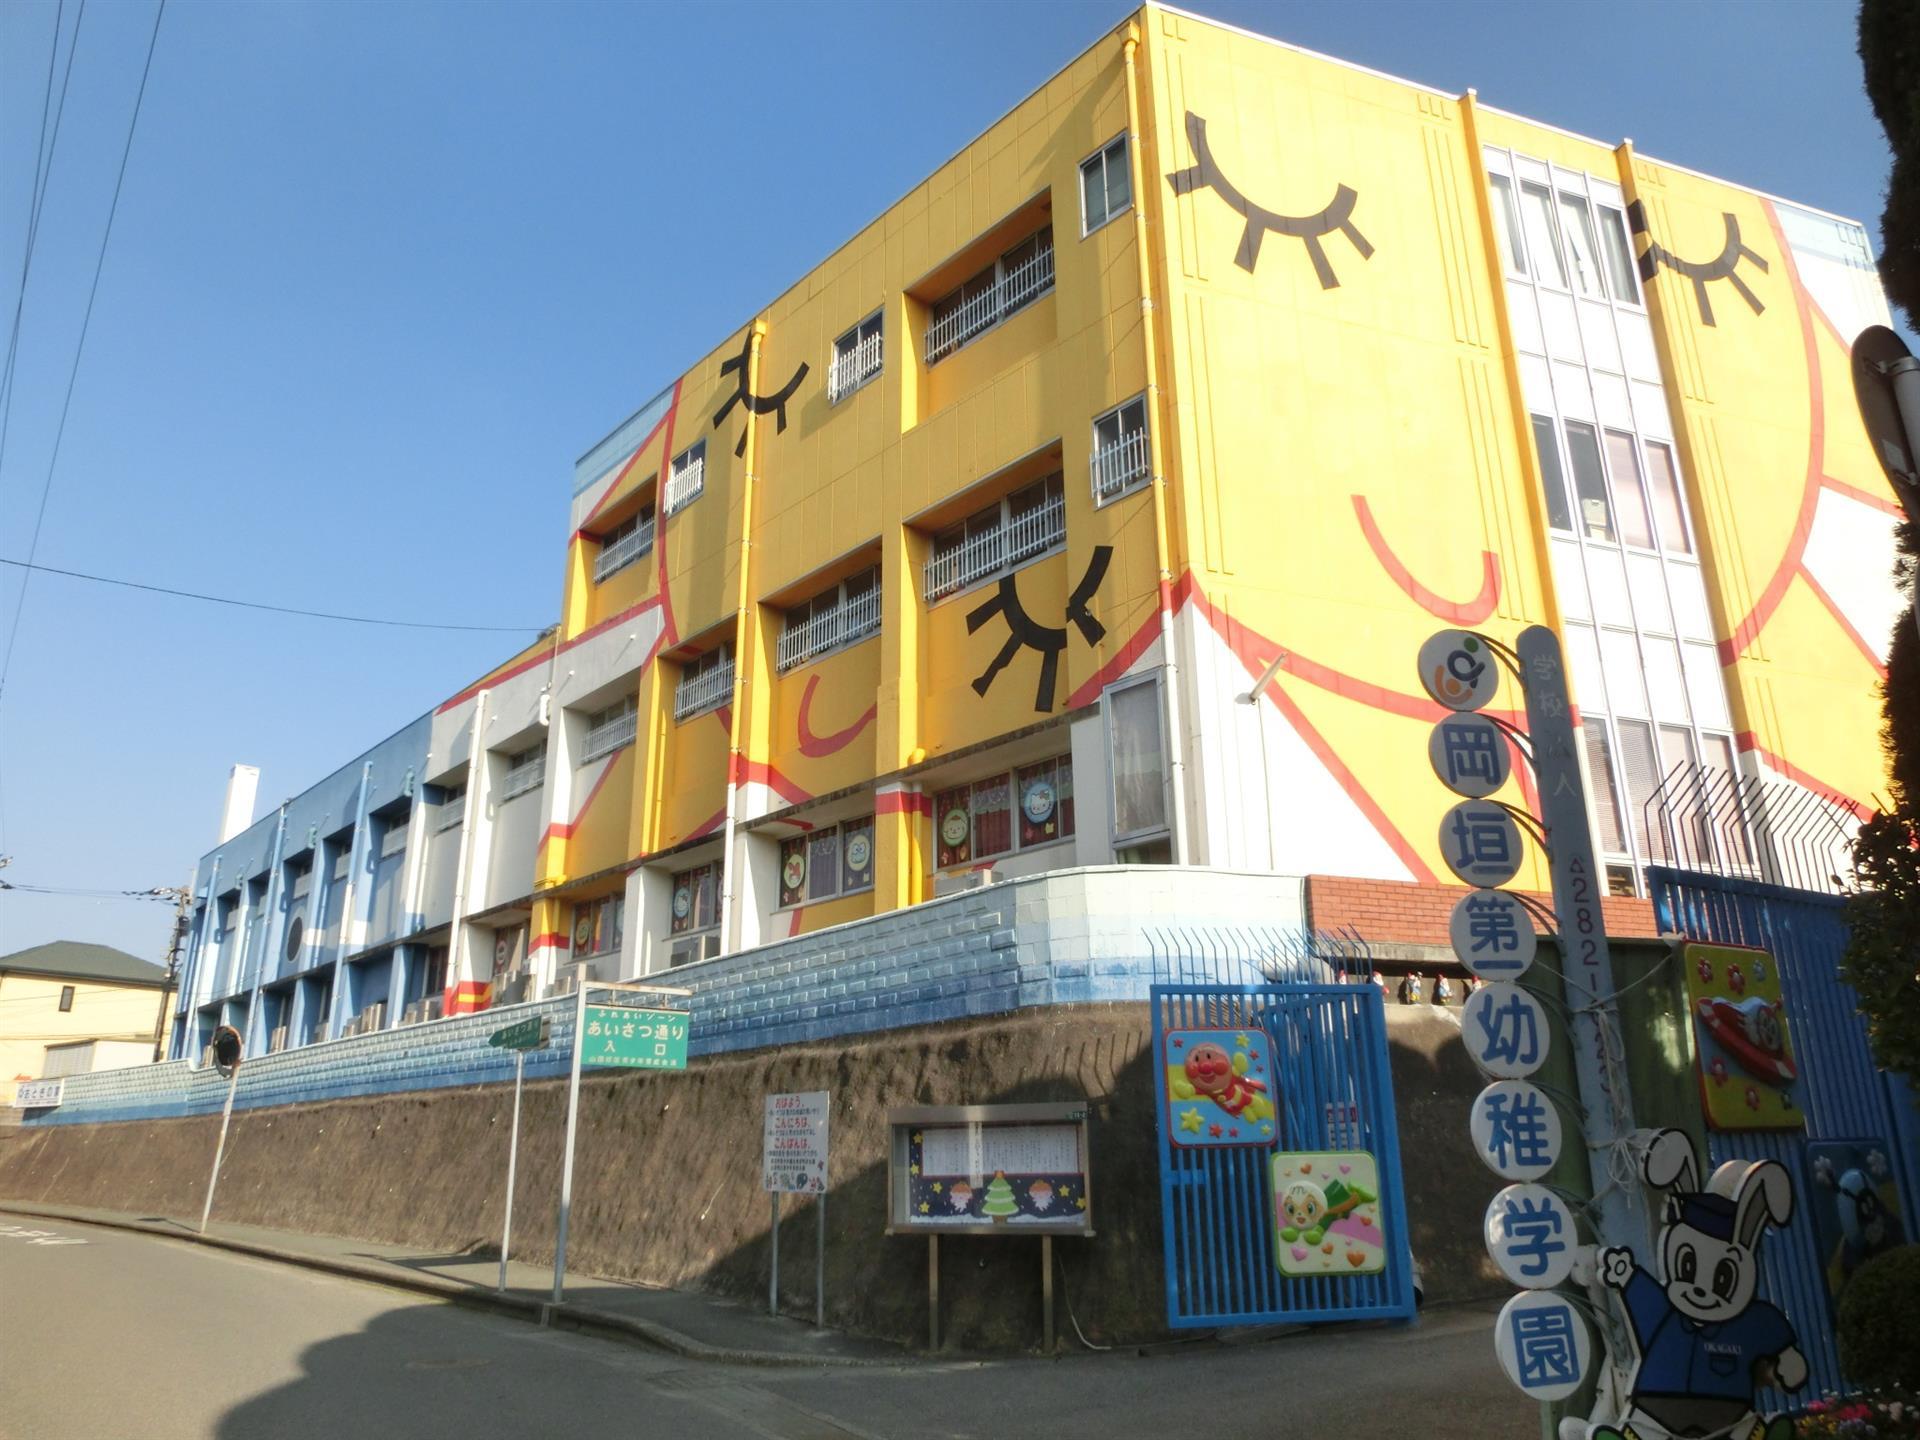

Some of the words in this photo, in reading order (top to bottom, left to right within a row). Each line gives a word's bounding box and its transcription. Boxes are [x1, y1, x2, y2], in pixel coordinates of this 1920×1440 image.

[1533, 654, 1577, 797] 学校人
[598, 1010, 676, 1022] ふれあいゾーン
[587, 1021, 685, 1041] あいさつ通り
